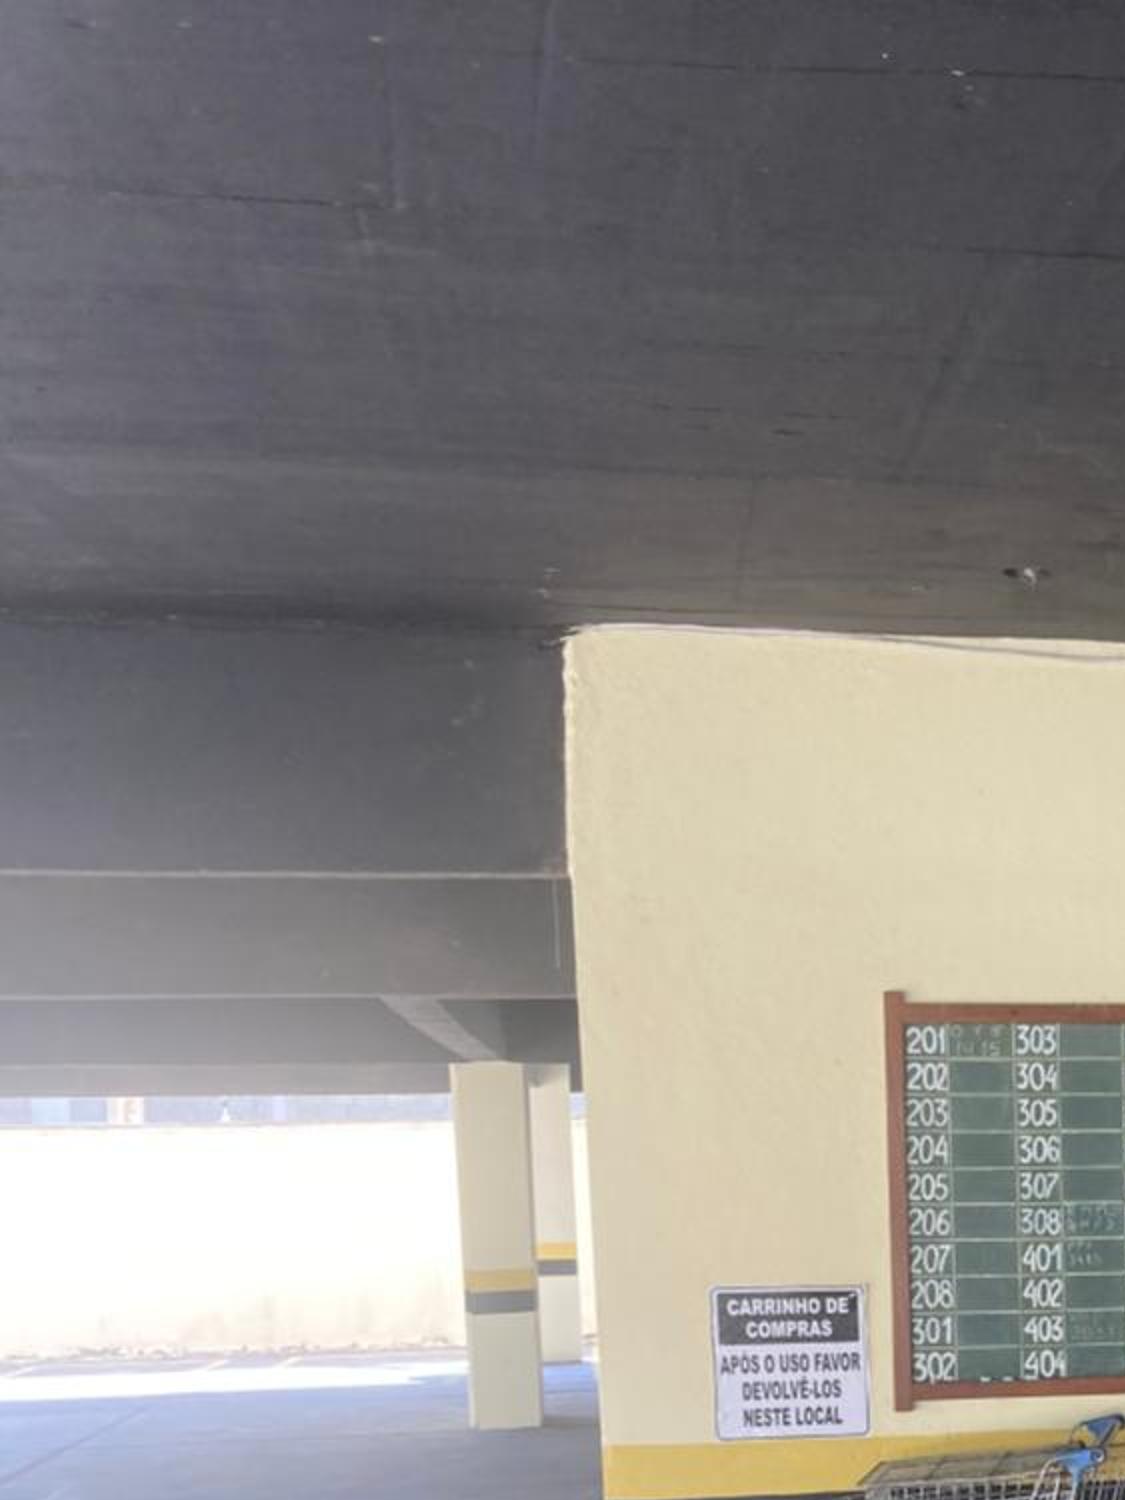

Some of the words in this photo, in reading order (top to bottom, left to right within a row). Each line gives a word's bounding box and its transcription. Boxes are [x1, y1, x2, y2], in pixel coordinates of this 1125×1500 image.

[906, 1026, 945, 1054] 201
[1016, 1026, 1056, 1055] 303
[906, 1063, 948, 1090] 202
[1017, 1063, 1056, 1090] 304
[907, 1100, 948, 1126] 203
[1018, 1100, 1056, 1126] 305
[907, 1136, 948, 1164] 204
[1020, 1136, 1060, 1163] 306
[909, 1174, 948, 1200] 205
[1020, 1174, 1058, 1199] 307
[909, 1209, 950, 1235] 206
[1021, 1209, 1061, 1235] 308
[911, 1245, 951, 1273] 207
[1023, 1245, 1062, 1271] 401
[727, 1298, 821, 1315] CARRINHO
[826, 1297, 849, 1313] DE
[911, 1281, 954, 1309] 208
[1024, 1280, 1063, 1307] 402
[746, 1320, 832, 1338] COMPRAS
[913, 1318, 952, 1344] 301
[1024, 1317, 1064, 1341] 403
[721, 1351, 760, 1375] APÓS
[764, 1354, 775, 1373] O
[780, 1354, 809, 1373] USO
[814, 1352, 861, 1372] FAVOR
[913, 1353, 956, 1383] 302
[1024, 1351, 1066, 1379] 404
[743, 1408, 791, 1427] NESTE
[796, 1406, 843, 1424] LOCAL
